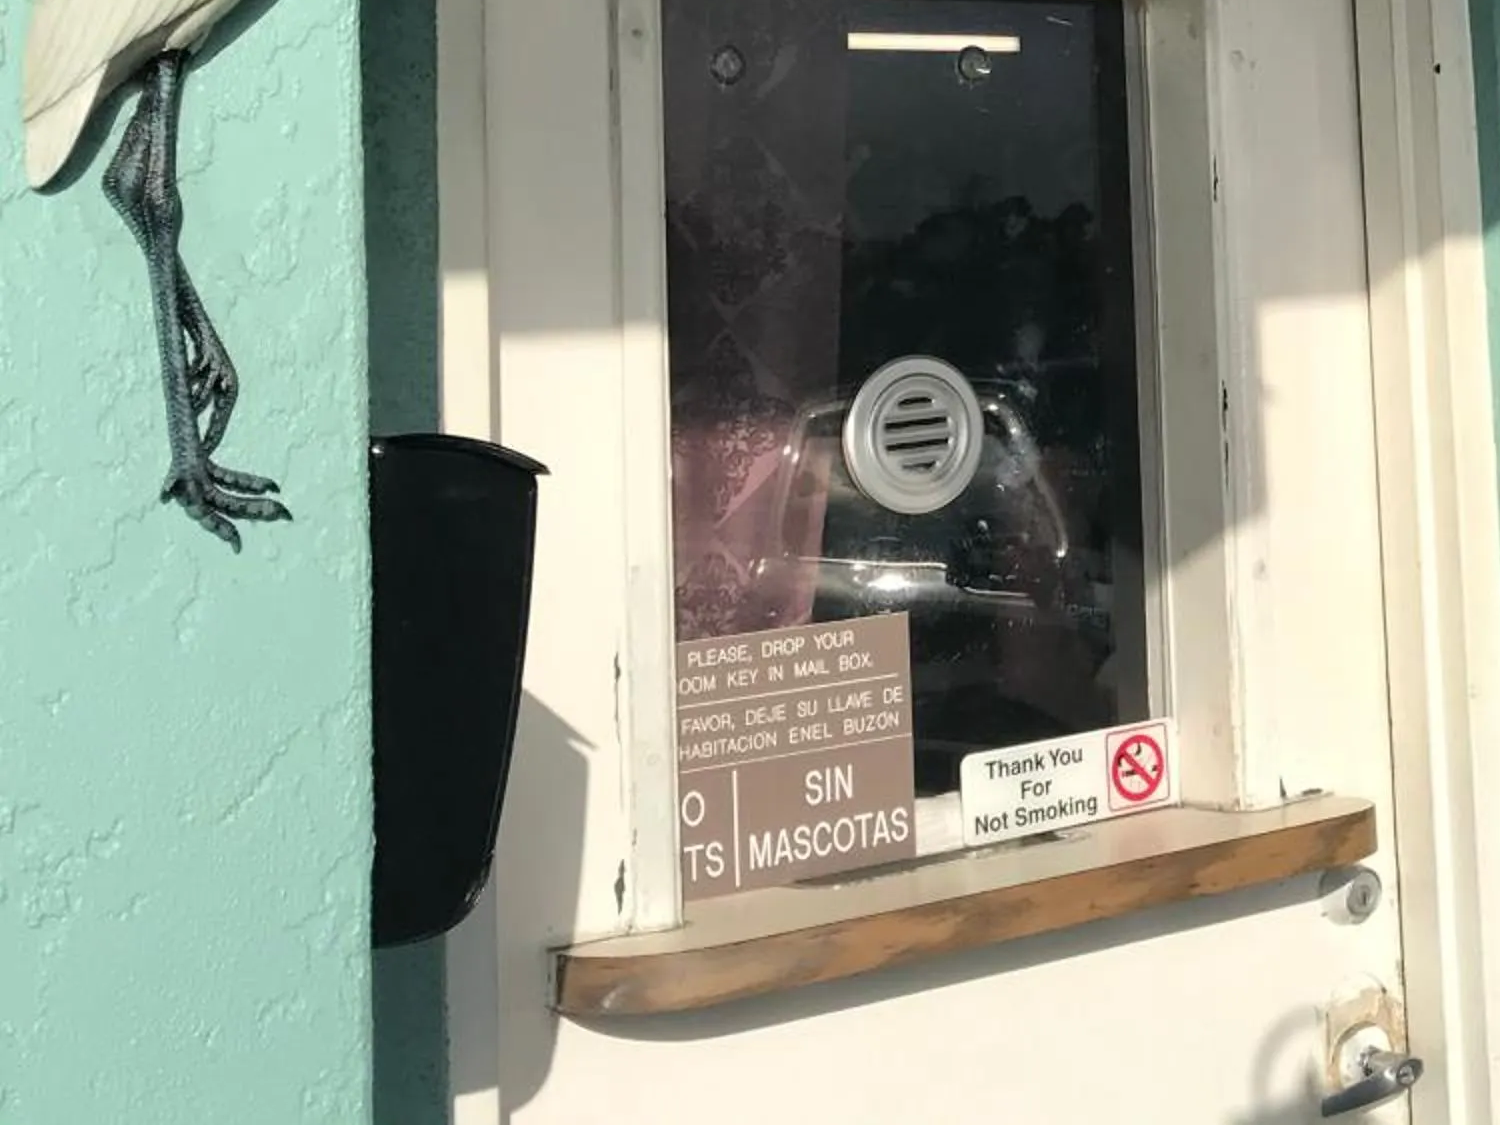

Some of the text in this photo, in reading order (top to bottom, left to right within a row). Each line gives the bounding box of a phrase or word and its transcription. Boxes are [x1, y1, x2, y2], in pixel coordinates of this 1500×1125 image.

[761, 636, 805, 658] DROP
[813, 629, 855, 650] YOUR
[679, 673, 718, 695] OOM
[726, 666, 759, 690] KEY
[767, 663, 784, 682] IN
[793, 658, 830, 678] MAIL
[744, 703, 787, 726] DEJE
[797, 698, 818, 718] SU
[826, 690, 873, 714] LLAVE
[882, 684, 904, 705] DE
[984, 747, 1083, 781] Thank You
[804, 763, 854, 806] SIN
[1020, 778, 1053, 801] For
[681, 790, 705, 828] O
[974, 795, 1098, 836] Not Smoking
[748, 806, 910, 871] MASCOTAS
[683, 841, 726, 882] TS
